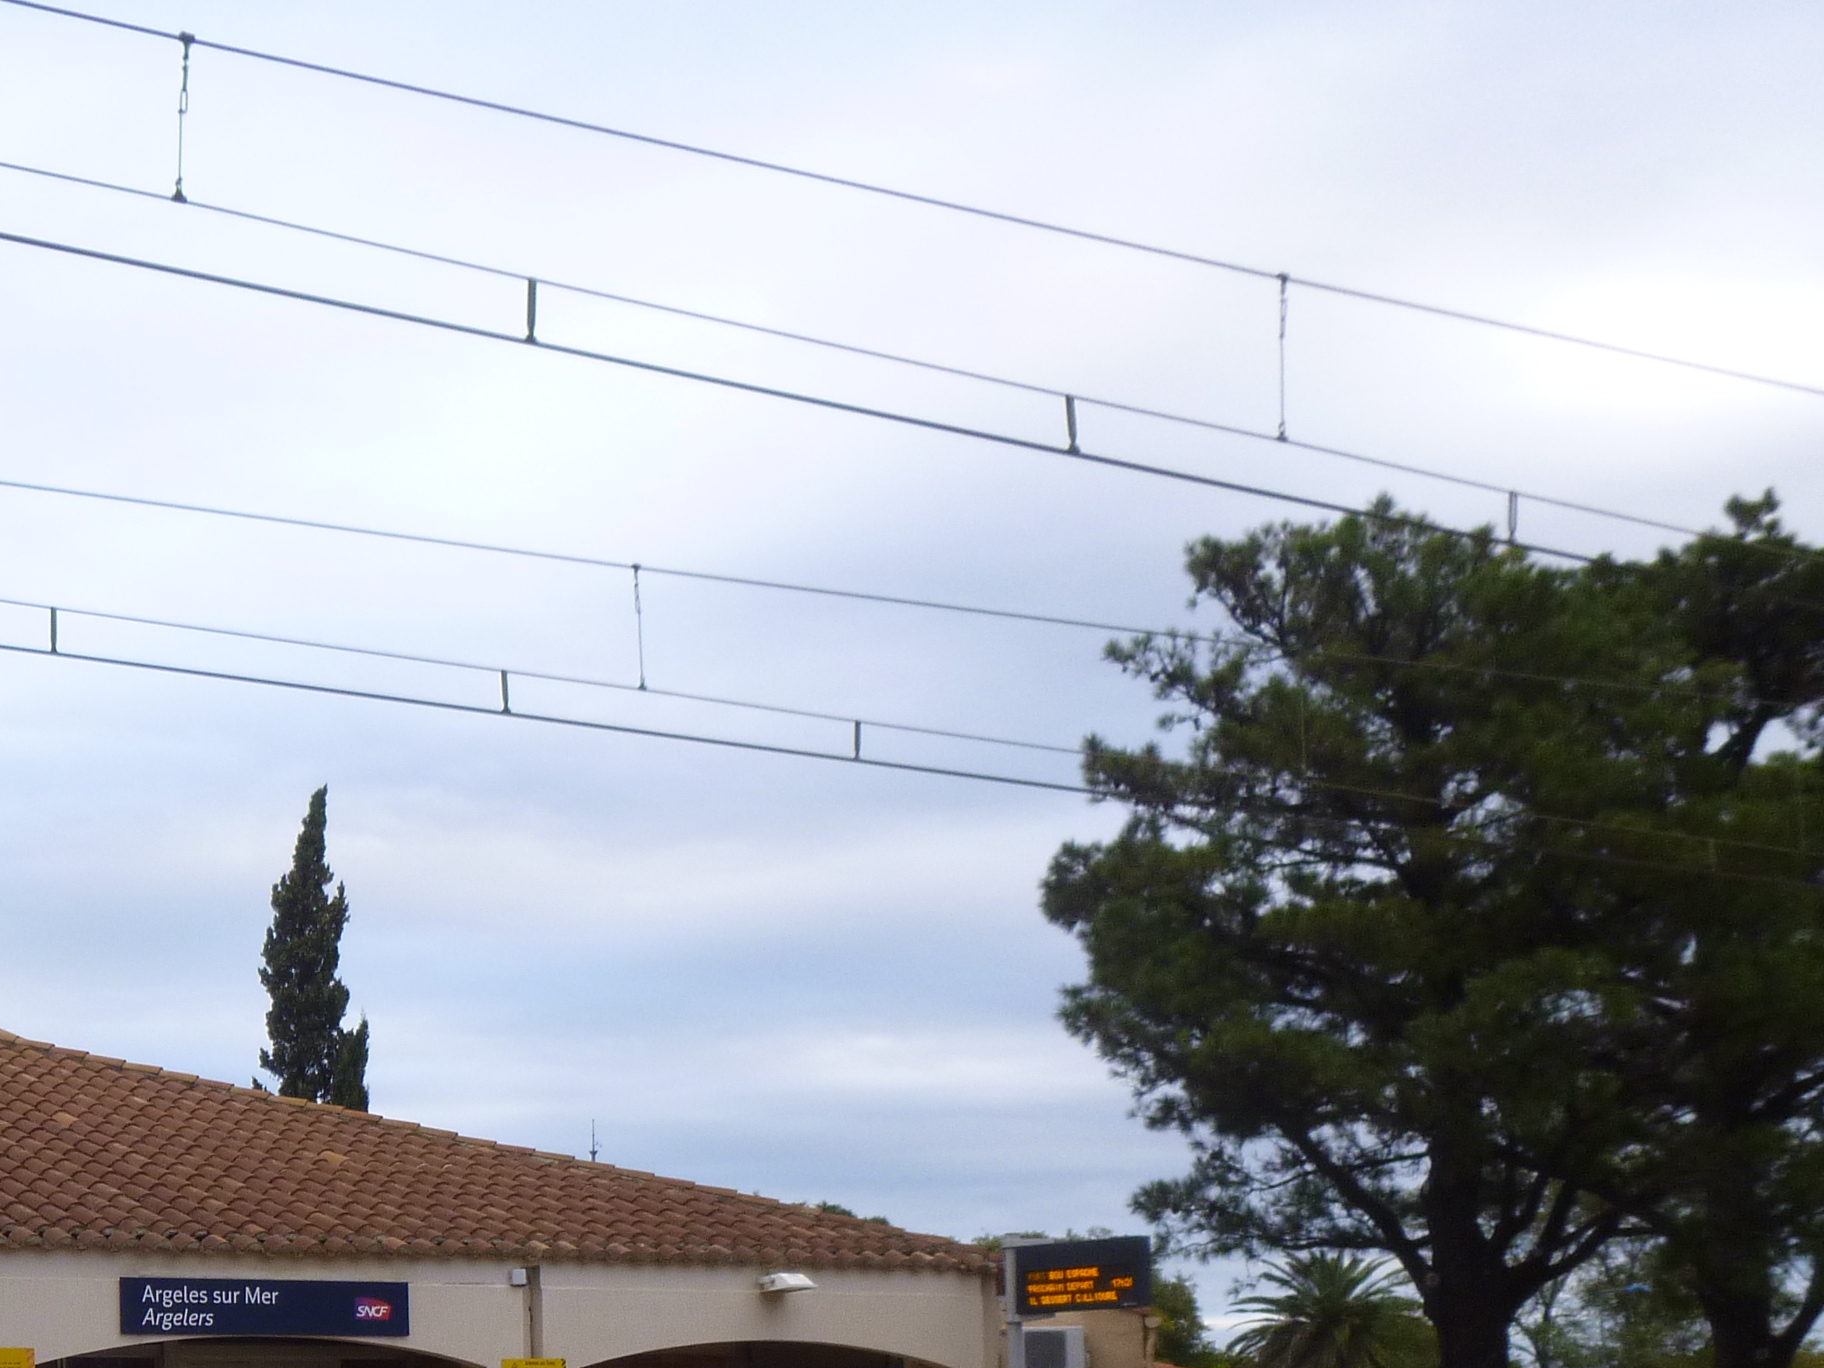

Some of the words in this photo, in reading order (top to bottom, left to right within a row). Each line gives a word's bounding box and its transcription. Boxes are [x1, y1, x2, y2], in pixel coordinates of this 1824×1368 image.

[142, 1284, 208, 1308] Argeles
[213, 1290, 240, 1304] sur
[245, 1286, 279, 1305] Mer
[142, 1307, 214, 1331] Argelers
[356, 1305, 388, 1317] SNCF
